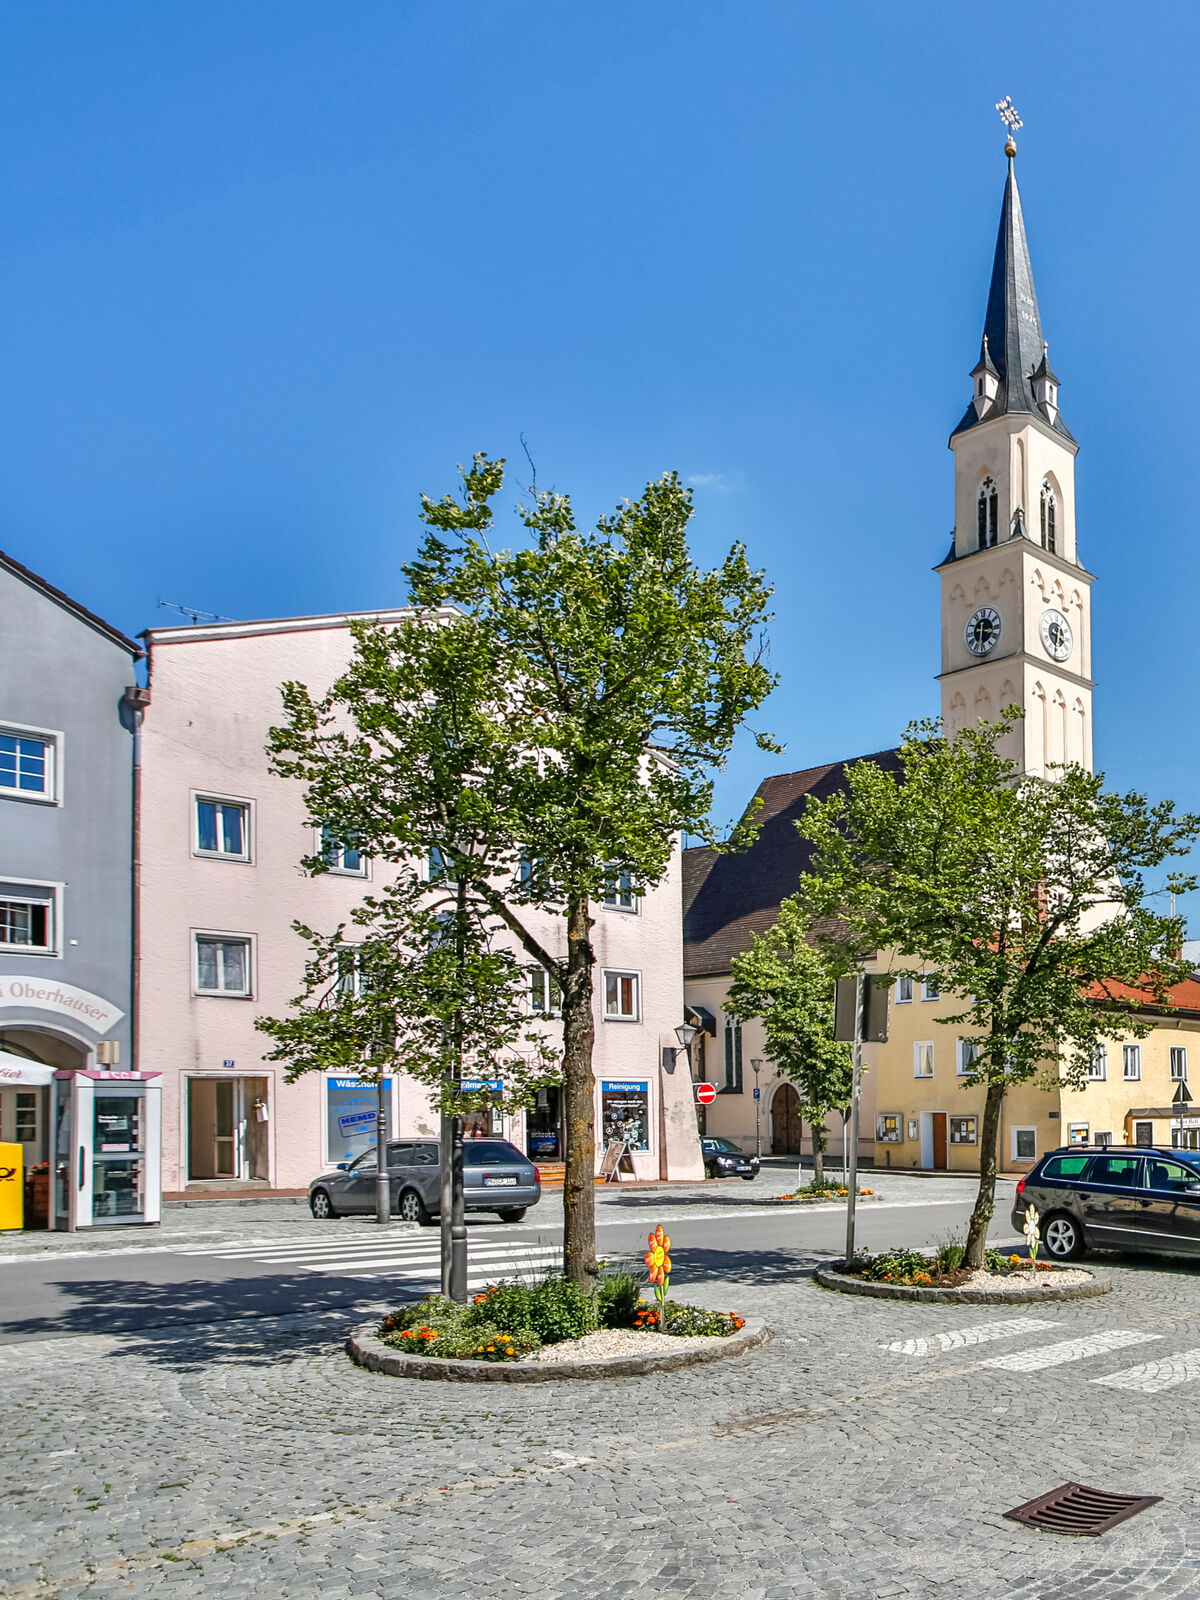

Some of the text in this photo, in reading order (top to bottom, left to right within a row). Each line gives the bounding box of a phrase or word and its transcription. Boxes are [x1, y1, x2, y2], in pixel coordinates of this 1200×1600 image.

[10, 982, 108, 1021] Oberhauser
[608, 1082, 641, 1092] Reinigung
[754, 1089, 759, 1097] P
